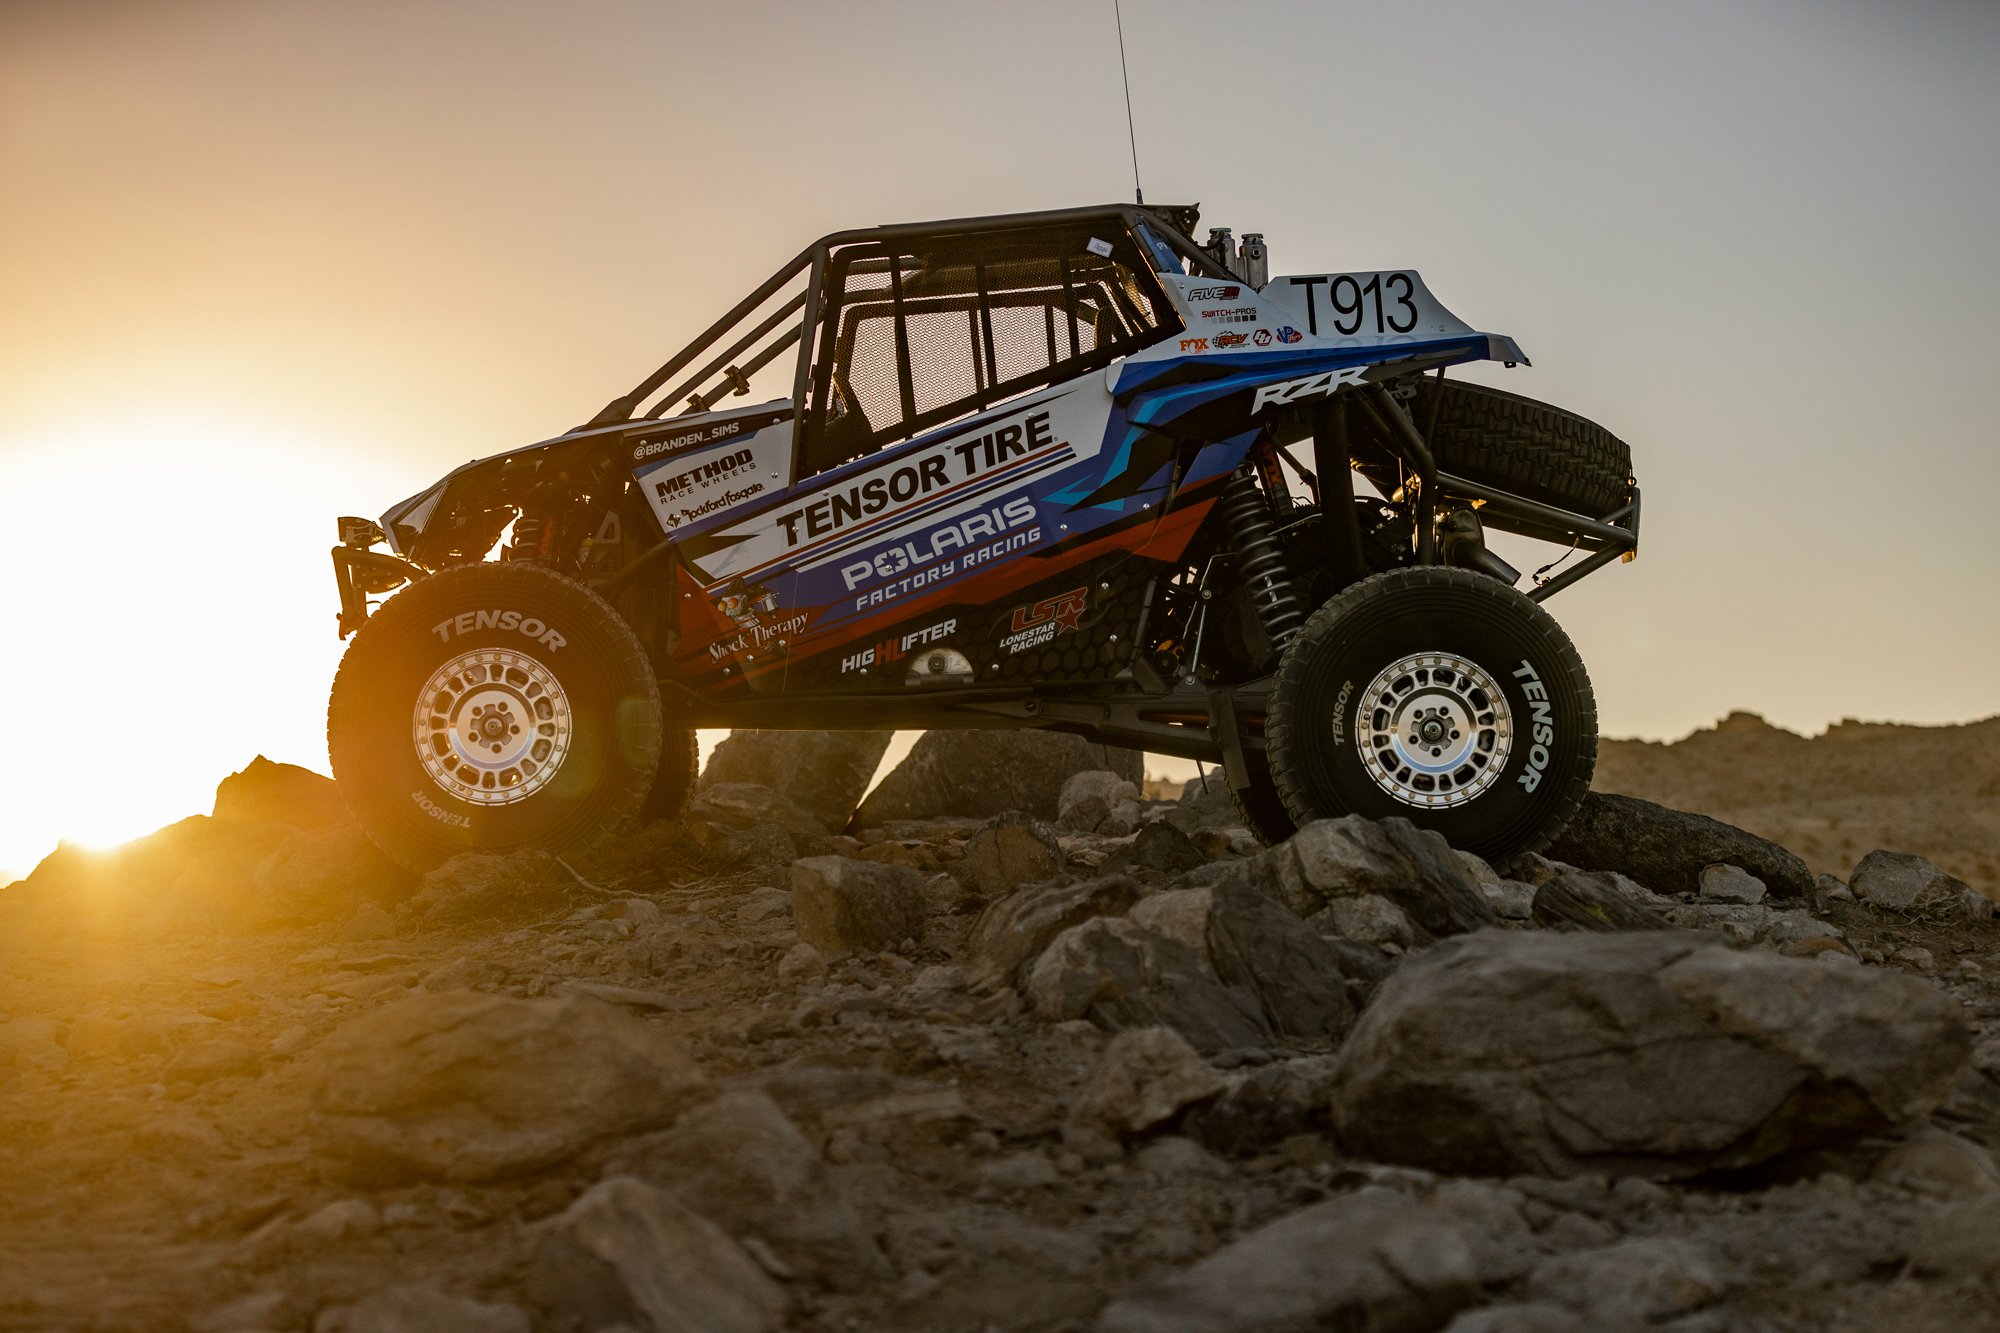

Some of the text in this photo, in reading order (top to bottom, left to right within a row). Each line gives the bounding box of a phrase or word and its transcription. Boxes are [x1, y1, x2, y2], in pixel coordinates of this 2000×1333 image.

[1201, 307, 1257, 318] SWITCH-PROS
[1290, 273, 1418, 335] T913
[1180, 338, 1209, 352] FOX
[1218, 333, 1249, 345] RCV
[1251, 365, 1370, 416] RZR
[633, 422, 740, 460] @BRANDEN_SIMS
[655, 449, 753, 497] METHOD
[660, 463, 756, 504] RACE WHEELS
[776, 411, 1053, 547] TENSOR TIRE
[681, 496, 726, 521] Rockford
[841, 495, 1037, 591] POLARIS
[856, 527, 1041, 612] FACTORY RACING
[431, 609, 568, 654] TENSOR
[1010, 586, 1089, 632] LSR
[709, 612, 809, 664] Shock Therapy
[841, 618, 958, 674] HIGHLIFTER
[999, 622, 1055, 649] LONESTAR
[1010, 632, 1055, 656] RACING
[1332, 680, 1355, 746] TENSOR
[1511, 659, 1554, 794] TENSOR
[412, 790, 471, 828] TENSOR
